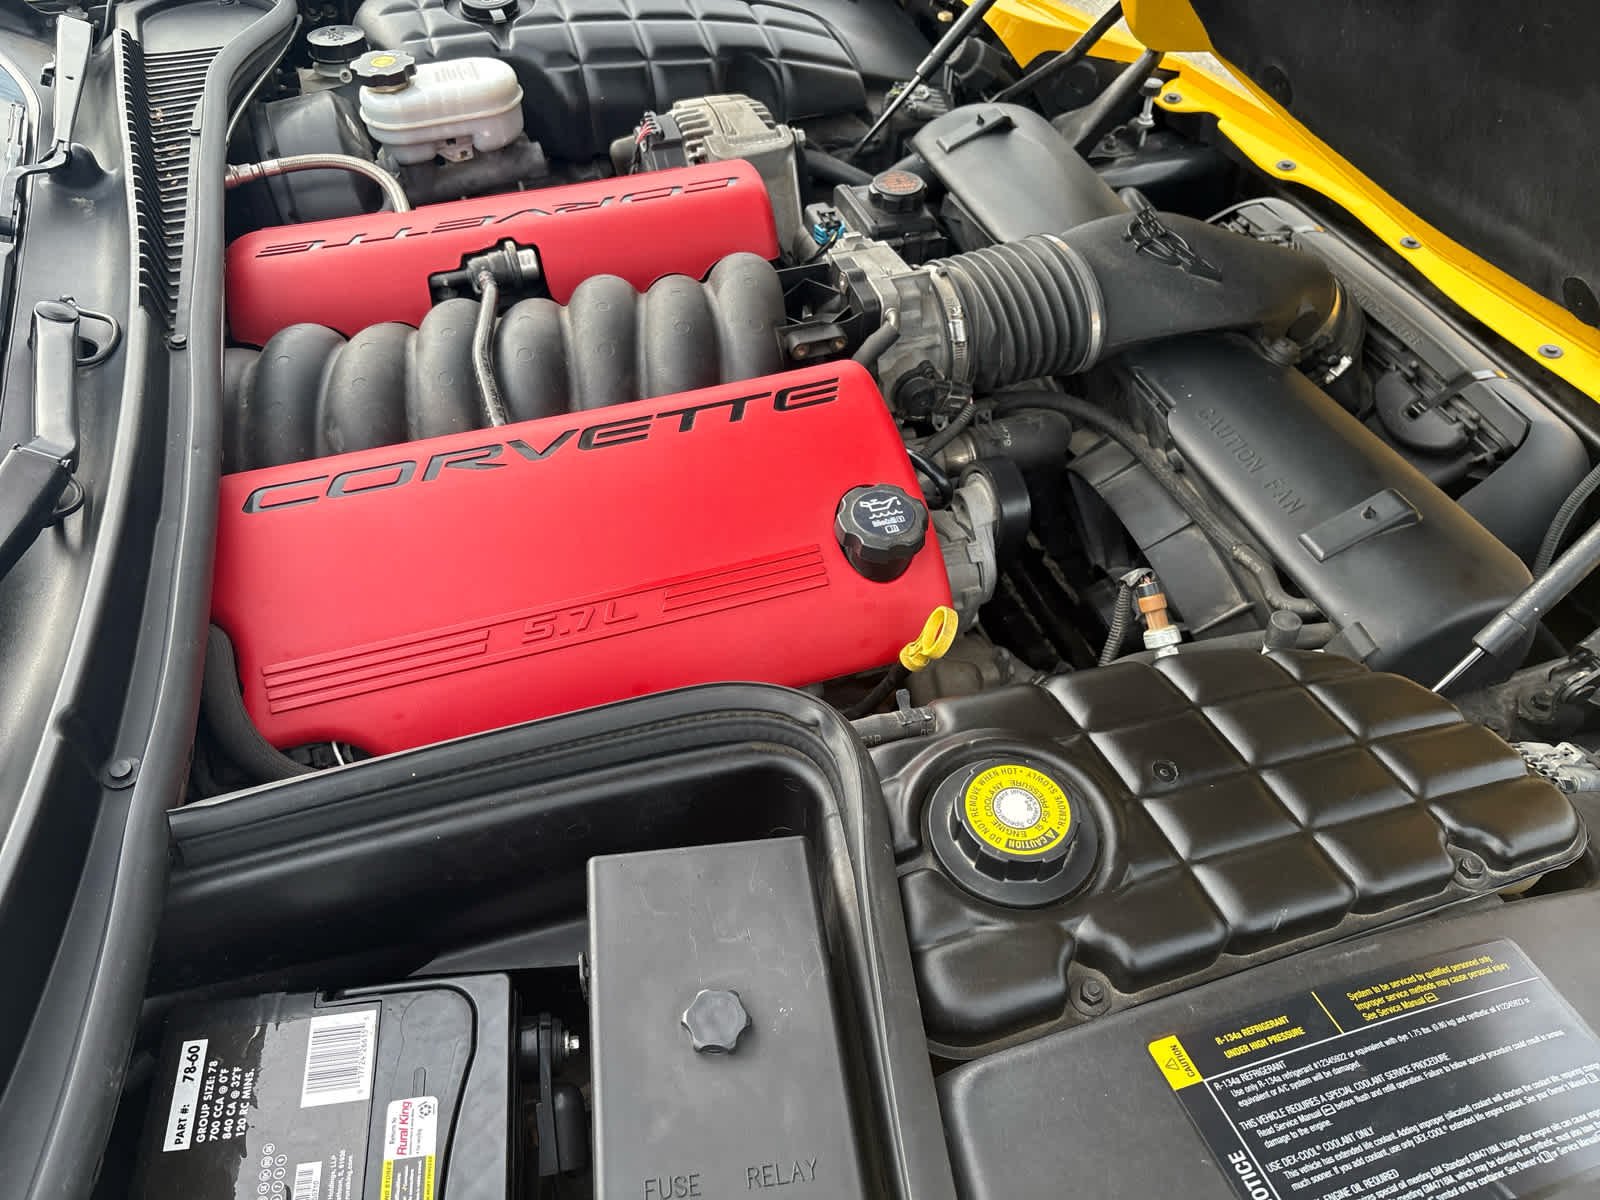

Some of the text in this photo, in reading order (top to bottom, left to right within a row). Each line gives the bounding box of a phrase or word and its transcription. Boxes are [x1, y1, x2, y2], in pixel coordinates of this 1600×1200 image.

[255, 176, 740, 258] CORVETTE
[240, 380, 840, 515] CORVETTE
[1198, 407, 1306, 515] CAUTION FAN
[520, 599, 641, 646] 5.7L
[978, 771, 999, 786] WHEN
[1000, 767, 1018, 775] HOT
[969, 785, 980, 818] REMOVE
[984, 782, 1003, 818] COOLANT
[1008, 780, 1049, 810] PRESSURE
[1027, 770, 1066, 827] REMOVE SLOWLY
[976, 818, 990, 836] NOT
[991, 820, 1027, 838] ENGINE
[1008, 837, 1046, 850] CAUTION
[1348, 988, 1373, 1001] System
[1390, 976, 1417, 988] serviced
[1424, 967, 1452, 979] qualified
[1356, 997, 1386, 1010] Improper
[1386, 992, 1410, 1001] service
[1409, 983, 1437, 995] methods
[1436, 979, 1452, 988] may
[1363, 997, 1427, 1020] See Service Manual
[1215, 1016, 1291, 1045] R-134a REFRIGERANT
[1224, 1027, 1306, 1058] UNDER HIGH PRESSURE
[1170, 1044, 1196, 1078] CAUTION
[1214, 1061, 1288, 1090] R-134a REFRIGERANT
[1231, 1088, 1246, 1097] Use
[1244, 1083, 1260, 1094] only
[1258, 1075, 1283, 1088] R-134a
[1282, 1065, 1315, 1081] refrigerant
[1354, 1042, 1387, 1057] equivalent
[174, 1046, 200, 1145] PART #: 78-60
[196, 1061, 218, 1142] GROUP SIZE: 78
[218, 1086, 228, 1094] @
[231, 1090, 240, 1099] @
[236, 1068, 254, 1137] 120 RC MINS.
[1237, 1091, 1271, 1108] equivalent
[1290, 1077, 1313, 1090] system
[1311, 1073, 1324, 1082] will
[1240, 1119, 1258, 1130] THIS
[1258, 1109, 1287, 1124] VEHICLE
[1286, 1097, 1322, 1116] REQUIRES
[1326, 1086, 1355, 1101] SPECIAL
[1354, 1075, 1387, 1091] COOLANT
[1385, 1066, 1413, 1080] SERVICE
[1411, 1053, 1452, 1071] PROCEDURE
[213, 1097, 224, 1118] CCA
[226, 1102, 237, 1116] CA
[398, 1101, 413, 1125] King
[1256, 1126, 1274, 1137] Read
[1274, 1117, 1299, 1131] Service
[1298, 1109, 1322, 1122] Manual
[1334, 1098, 1355, 1110] before
[1354, 1092, 1371, 1103] flush
[1370, 1088, 1383, 1098] and
[209, 1120, 220, 1141] 700
[222, 1119, 233, 1140] 840
[396, 1127, 409, 1156] Rural
[1264, 1134, 1291, 1149] damage
[1298, 1127, 1310, 1136] the
[1266, 1127, 1376, 1172] USE COOLANT ONLY
[1284, 1168, 1299, 1179] This
[1298, 1160, 1322, 1174] vehicle
[1321, 1155, 1335, 1165] has
[1334, 1145, 1364, 1160] extended
[1397, 1125, 1420, 1139] Adding
[1418, 1115, 1447, 1131] improper
[1291, 1177, 1311, 1190] much
[1338, 1162, 1354, 1173] you
[1351, 1157, 1365, 1167] add
[1389, 1145, 1402, 1153] use
[1400, 1138, 1416, 1150] only
[1448, 1116, 1476, 1130] extended
[643, 1158, 818, 1200] FUSE RELAY
[1227, 1150, 1270, 1200] OTICE
[1350, 1168, 1402, 1193] OIL REQUIRED
[1406, 1171, 1434, 1187] meeting
[1431, 1167, 1444, 1176] GM
[1442, 1156, 1472, 1172] Standard
